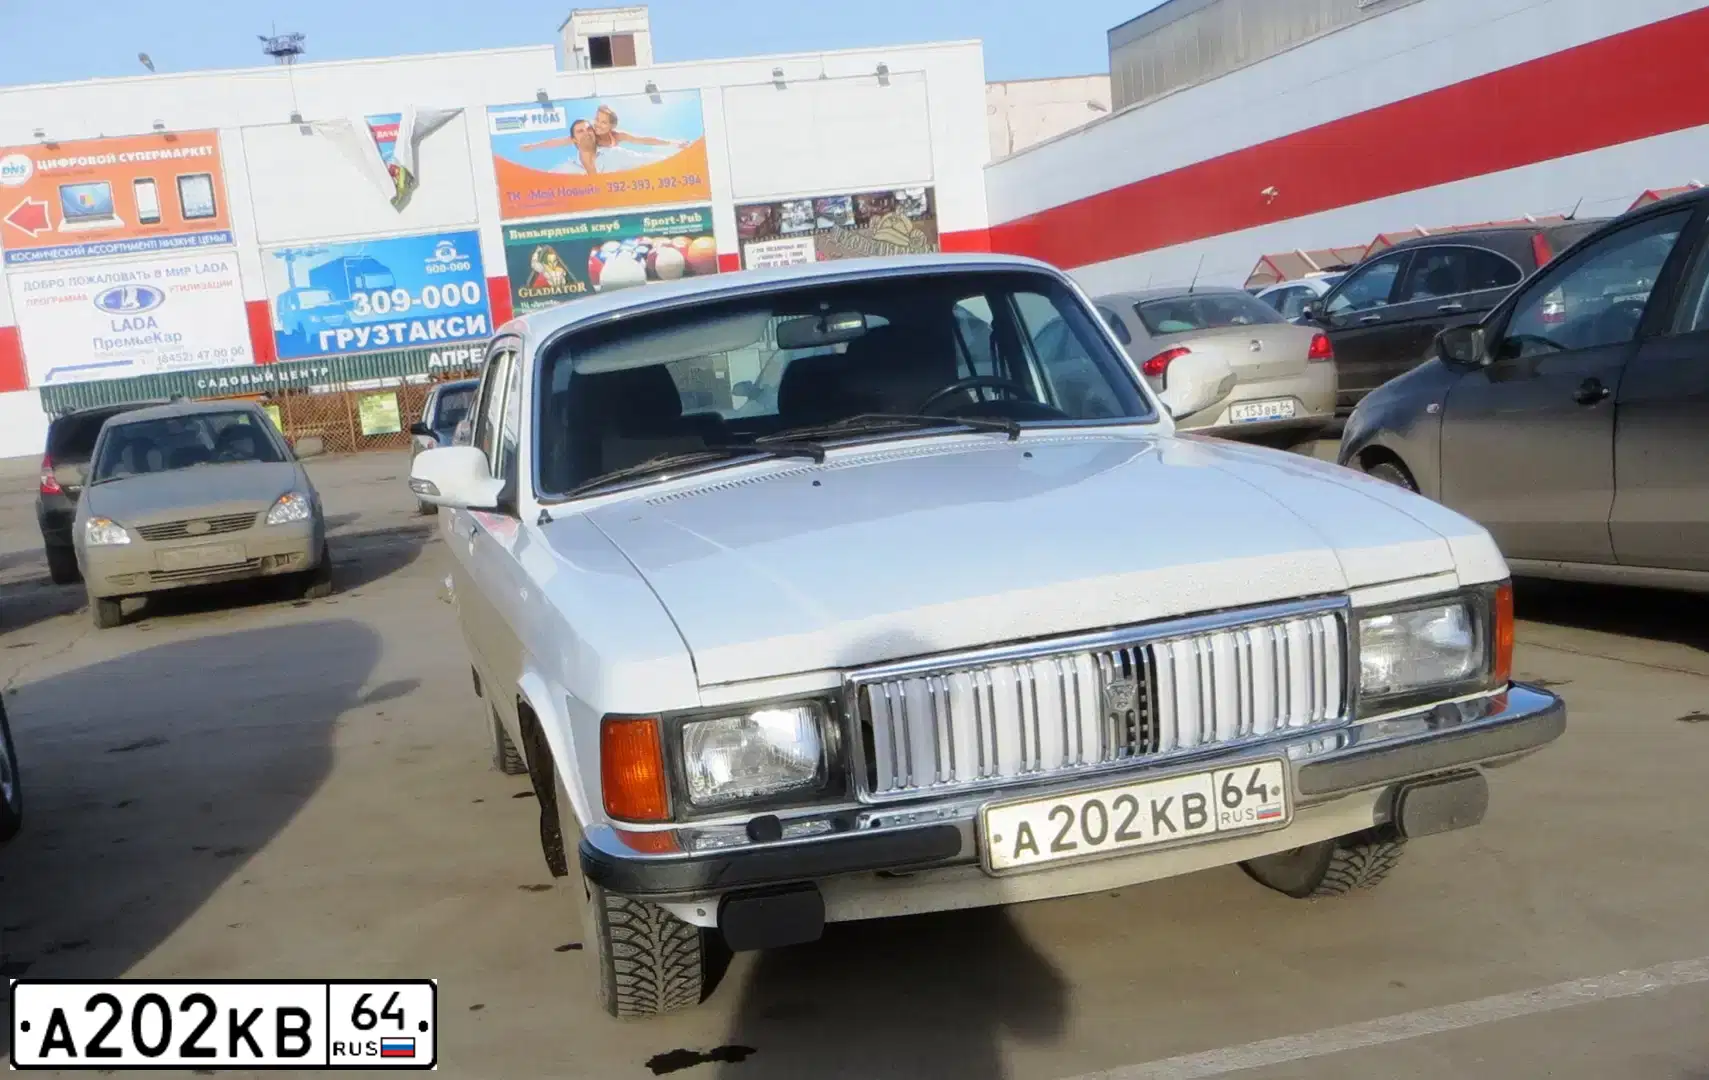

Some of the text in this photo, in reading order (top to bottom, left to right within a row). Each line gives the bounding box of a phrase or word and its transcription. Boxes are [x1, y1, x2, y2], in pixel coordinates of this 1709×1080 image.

[531, 111, 561, 124] PEGAS
[2, 161, 25, 175] DNS
[36, 145, 213, 171] ЦИФРОВОЙ СУПЕРМАРКЕТ
[591, 219, 620, 234] клуб
[643, 212, 703, 228] Sport-Pub
[11, 245, 87, 262] КОСМИЧЕСКИЙ
[158, 236, 198, 249] НИЗКИЕ
[23, 262, 229, 293] ДОБРО ПОЖАЛОВАТЬ В МИР LADA
[25, 279, 234, 308] ПРОГРАММА УТИЛИЗАЦИИ
[350, 281, 481, 317] 309-000
[517, 281, 587, 298] GLADIATOR
[110, 315, 158, 333] LADA
[319, 314, 487, 351] ГРУЗТАКСИ
[92, 332, 183, 352] ПремьеКар
[428, 347, 489, 368] АПРЕ
[197, 367, 329, 389] САДОВЫЙ ЦЕНТР
[1013, 767, 1267, 859] А202КВ 64
[1220, 809, 1255, 825] RUS
